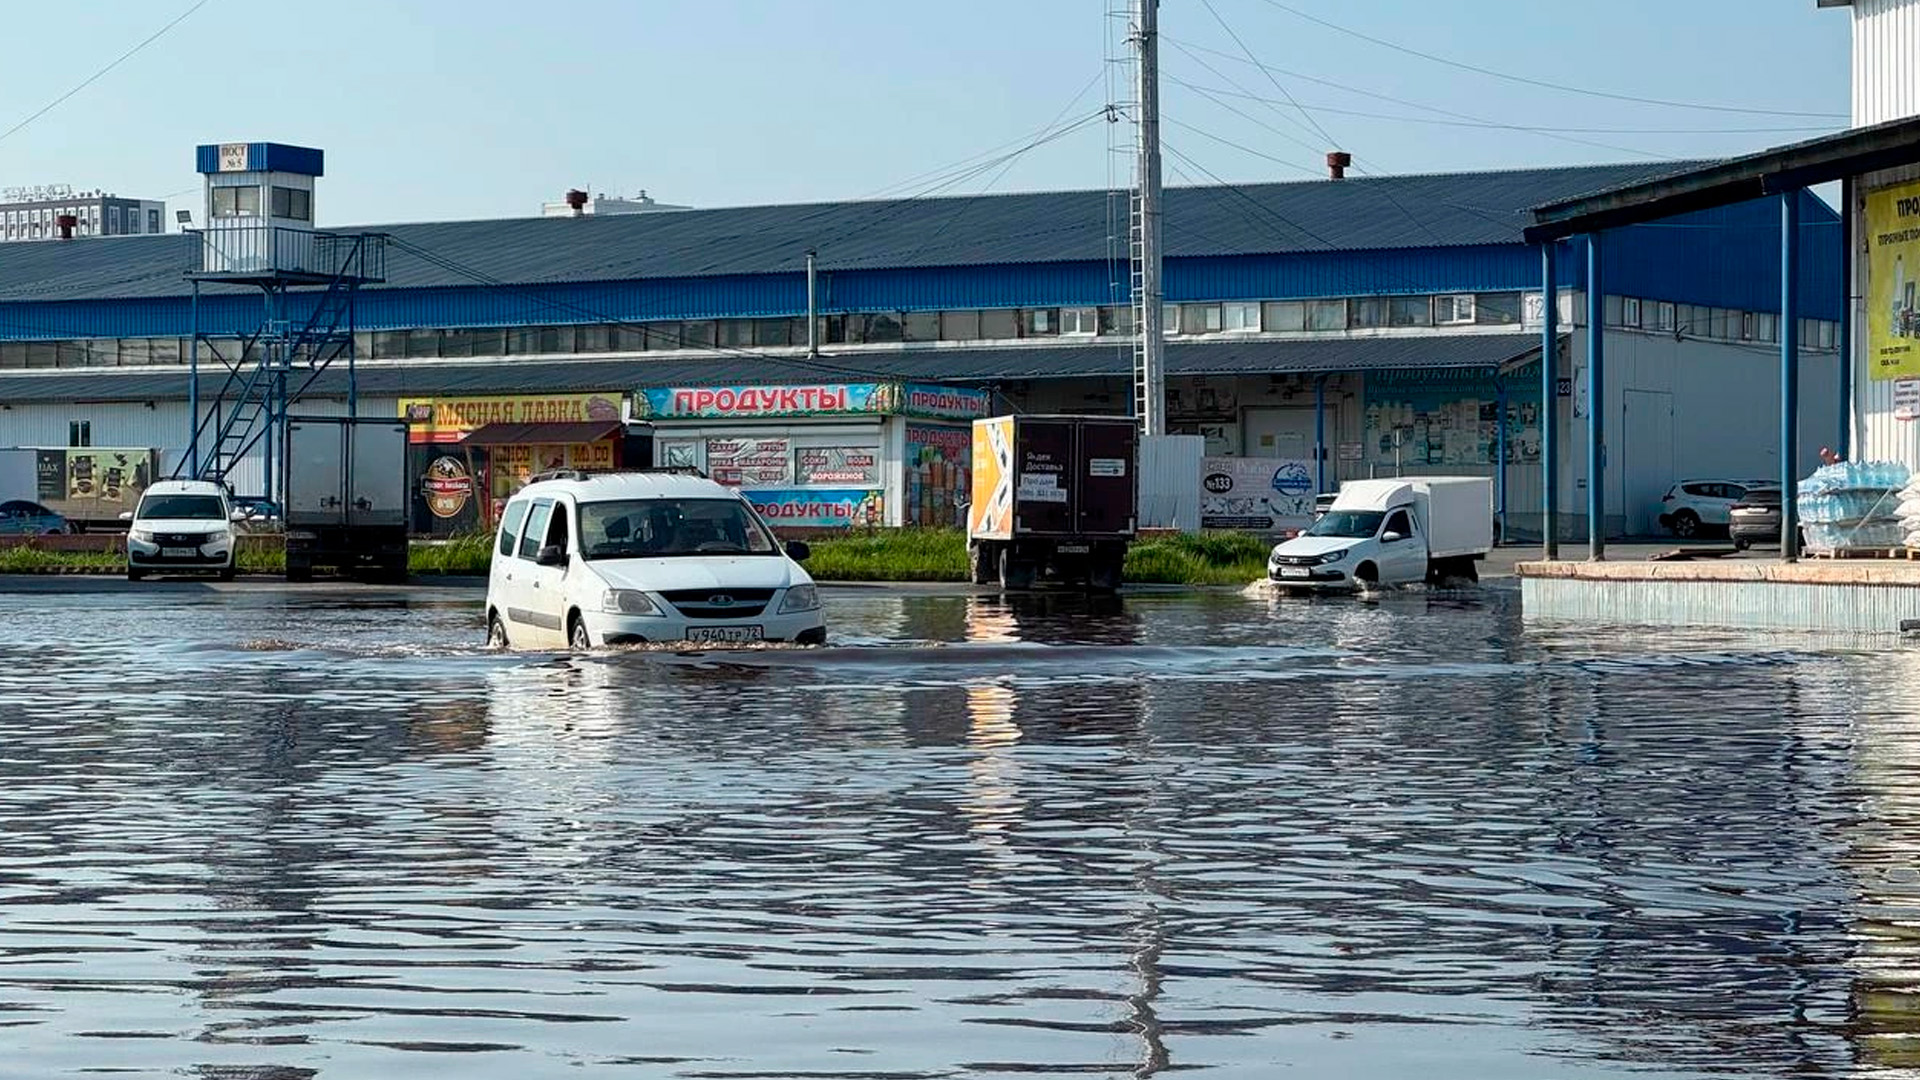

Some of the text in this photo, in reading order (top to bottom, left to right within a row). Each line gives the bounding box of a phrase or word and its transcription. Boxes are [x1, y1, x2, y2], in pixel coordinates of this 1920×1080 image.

[221, 146, 246, 157] ПОСТ
[1897, 196, 1920, 218] ПРО
[675, 388, 846, 411] ПРОДУКТЫ
[912, 392, 982, 411] ПРОДУКТЫ
[437, 401, 515, 426] МЯСНАЯ
[520, 398, 583, 422] ЛАВКА
[711, 458, 733, 466] МУКА
[739, 458, 786, 466] МАКАРОНЫ
[803, 457, 826, 465] СОКИ
[847, 457, 872, 466] ВОДА
[810, 472, 864, 481] МОРОЖЕНОЕ
[753, 503, 852, 517] РОДУКТЫ
